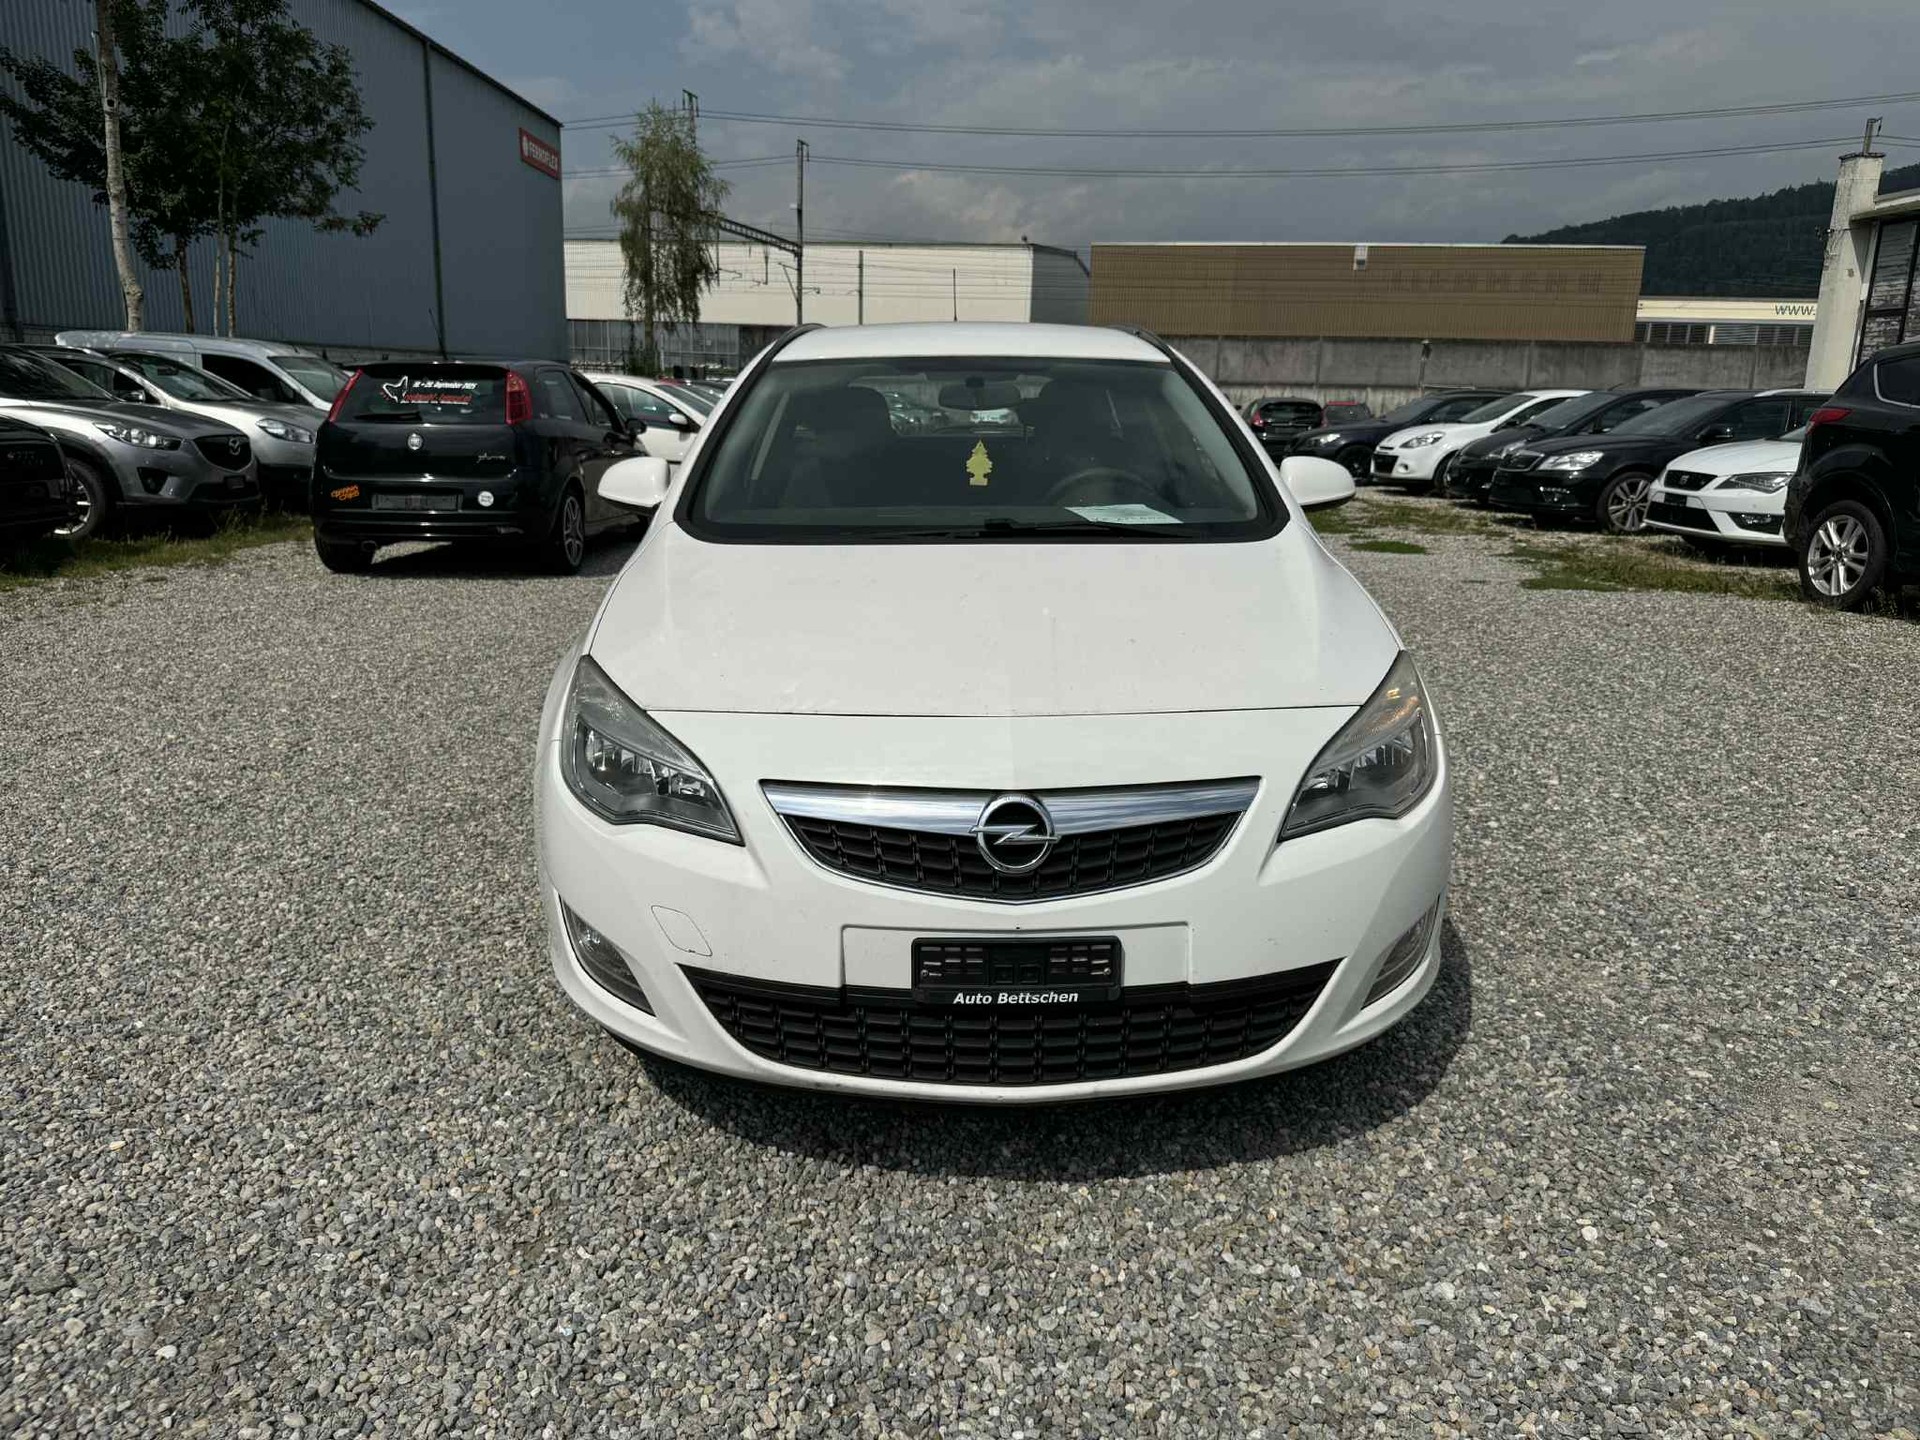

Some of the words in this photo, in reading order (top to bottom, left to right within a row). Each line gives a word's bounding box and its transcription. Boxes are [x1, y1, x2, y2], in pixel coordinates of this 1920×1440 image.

[1774, 304, 1816, 316] www.
[953, 992, 993, 1005] Auto
[997, 991, 1079, 1004] Bettschen
